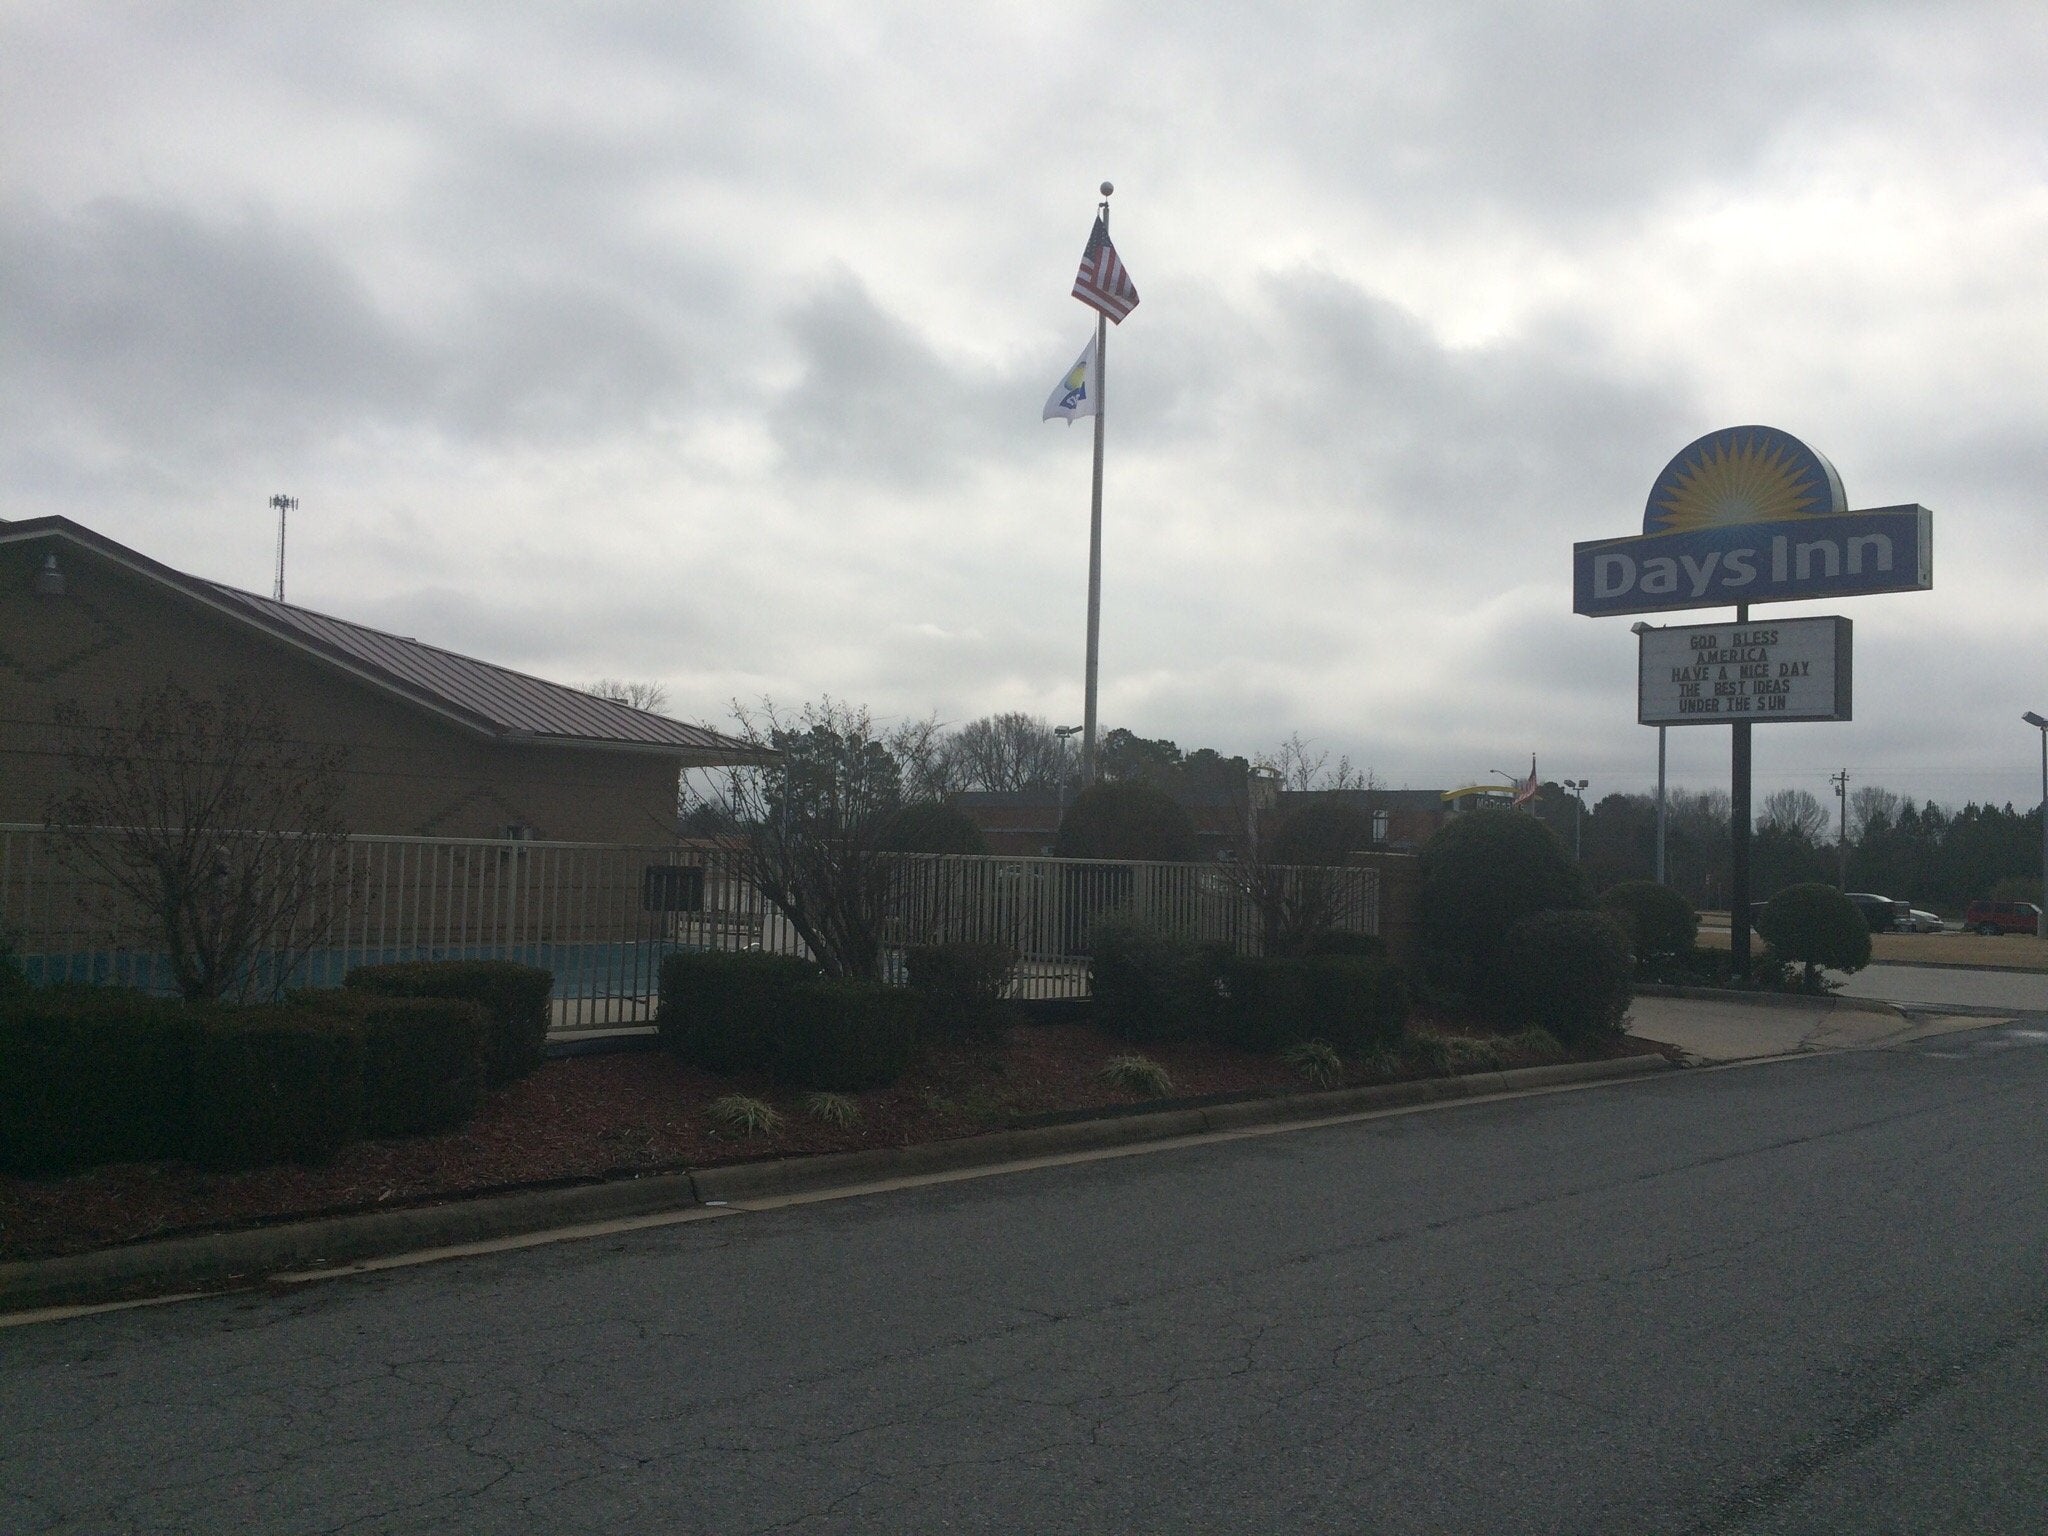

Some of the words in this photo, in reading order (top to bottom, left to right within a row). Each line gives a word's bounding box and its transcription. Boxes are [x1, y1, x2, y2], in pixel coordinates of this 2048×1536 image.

[1593, 548, 1757, 599] Days
[1772, 532, 1893, 582] Inn
[1690, 635, 1717, 650] GOD
[1732, 630, 1779, 648] BLESS
[1696, 647, 1768, 665] AMERICA
[1671, 666, 1710, 683] HAVE
[1718, 666, 1728, 680] A
[1739, 664, 1770, 679] NICE
[1778, 661, 1810, 677] DAY
[1679, 683, 1701, 698] THE
[1714, 680, 1746, 696] BEST
[1752, 679, 1790, 695] IDEAS
[1679, 698, 1720, 713] UNDER
[1726, 697, 1751, 712] THE
[1757, 695, 1786, 711] SUN
